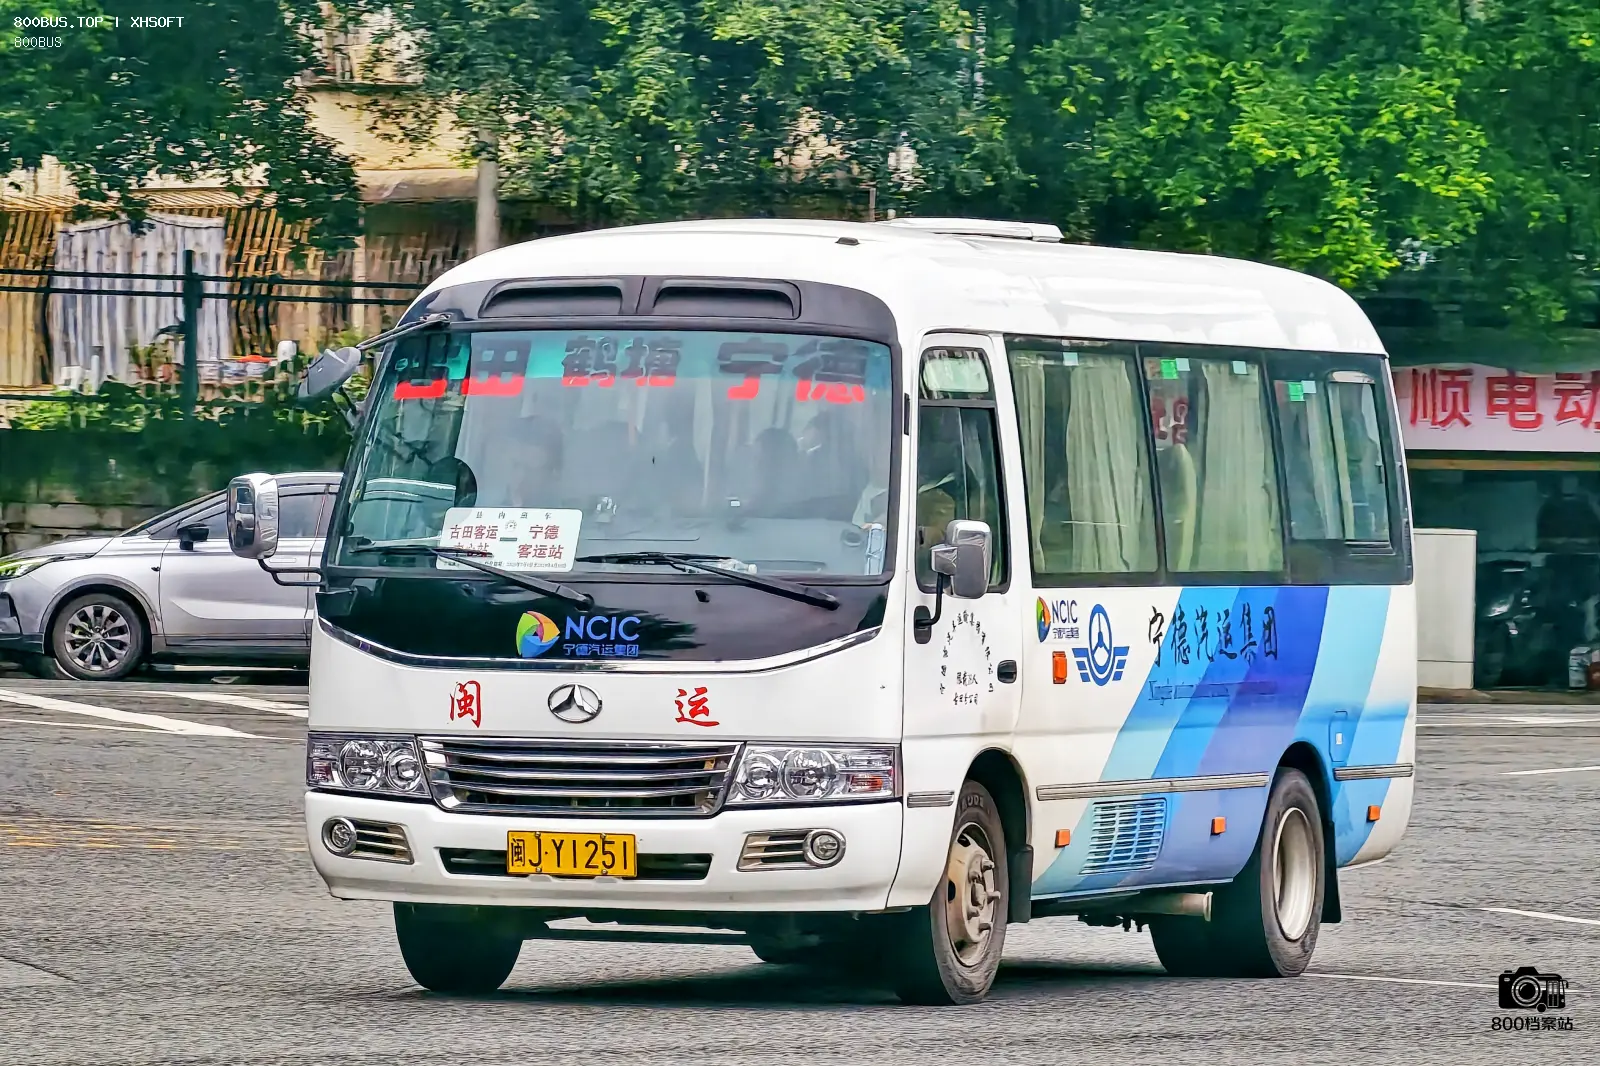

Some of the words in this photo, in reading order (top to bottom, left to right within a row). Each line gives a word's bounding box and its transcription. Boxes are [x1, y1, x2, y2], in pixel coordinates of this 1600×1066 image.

[716, 337, 868, 404] 宁德
[450, 524, 499, 540] 古田客运
[529, 524, 560, 540] 宁德
[517, 544, 564, 560] 客运站
[1052, 599, 1078, 624] NCIC
[565, 615, 641, 641] NCIC
[449, 680, 481, 728] 闽
[674, 687, 720, 727] 运
